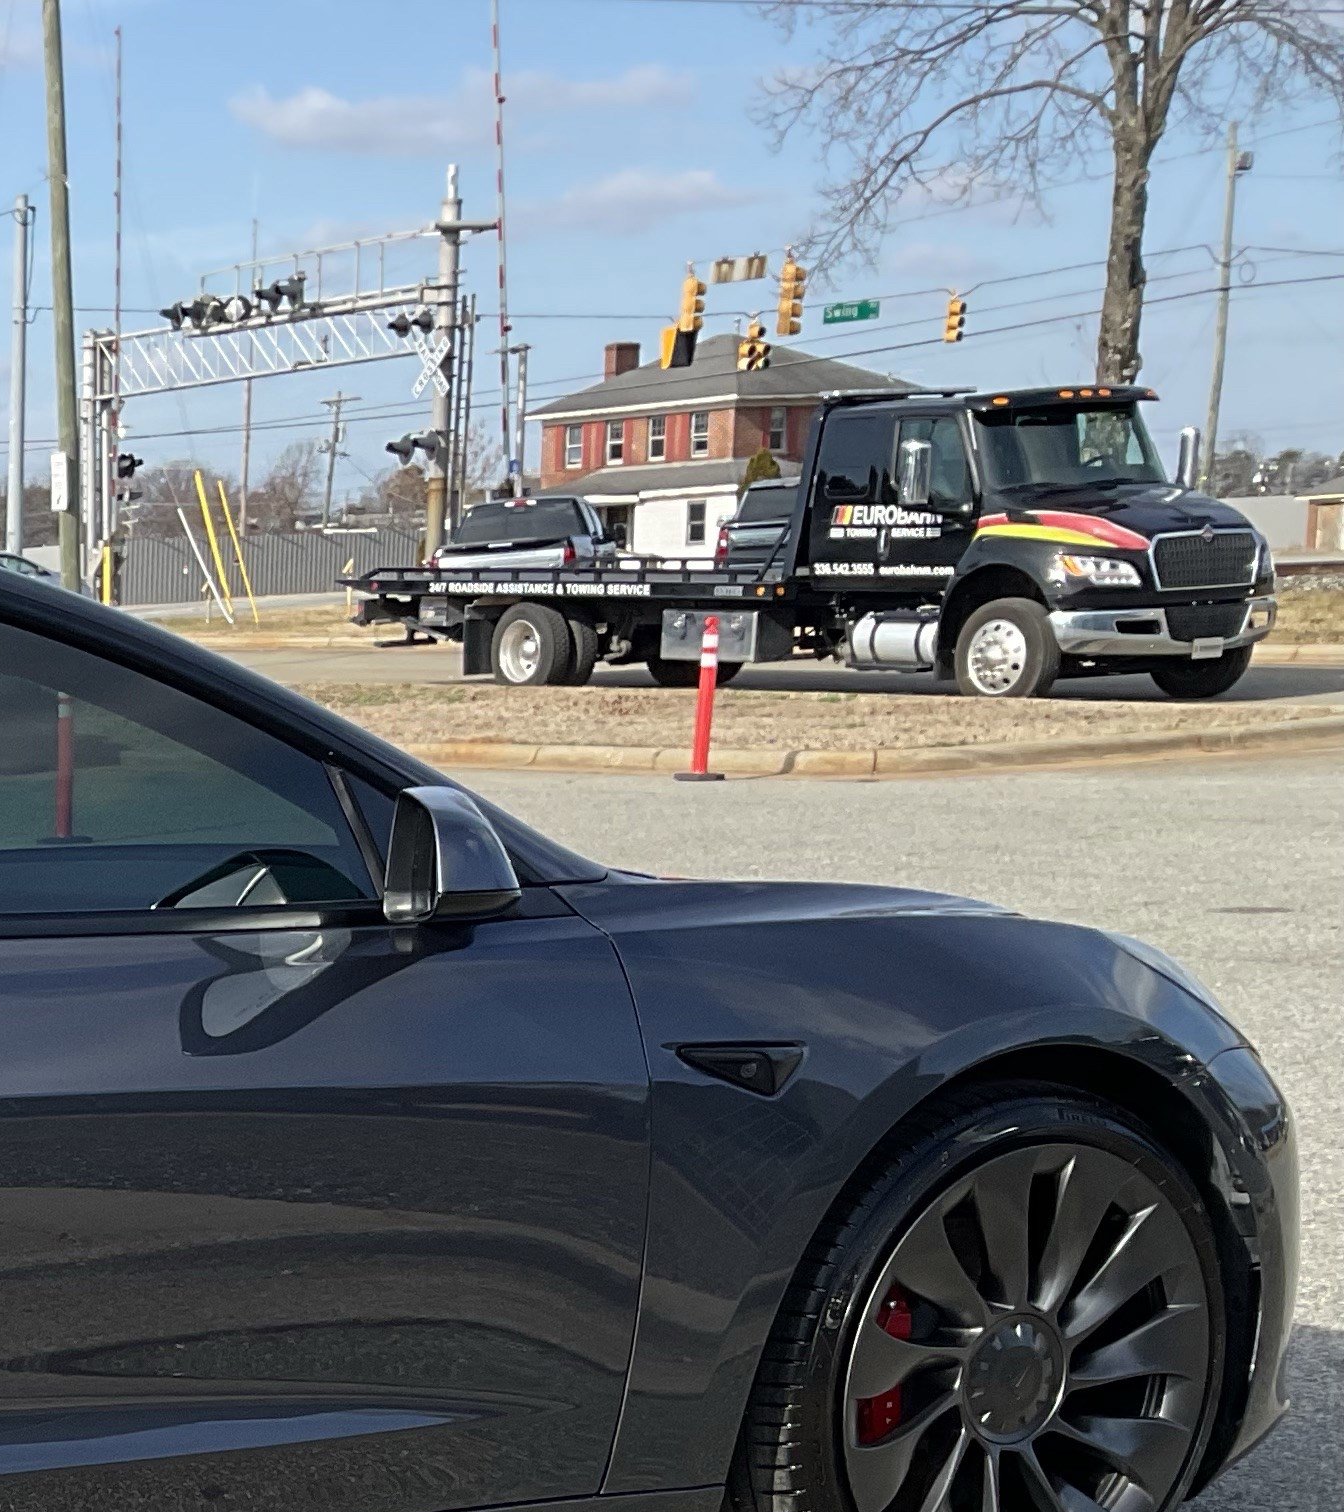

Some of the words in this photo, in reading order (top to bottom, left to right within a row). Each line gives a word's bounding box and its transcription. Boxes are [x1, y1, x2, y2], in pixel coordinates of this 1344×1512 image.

[845, 527, 878, 538] TOWING
[890, 527, 925, 538] SERVICE
[429, 582, 447, 593] 24/7
[448, 582, 494, 593] ROADSIDE
[495, 582, 554, 594] ASSISTANCE
[555, 584, 564, 595] &
[565, 583, 605, 595] TOWING
[606, 583, 651, 597] SERVICE
